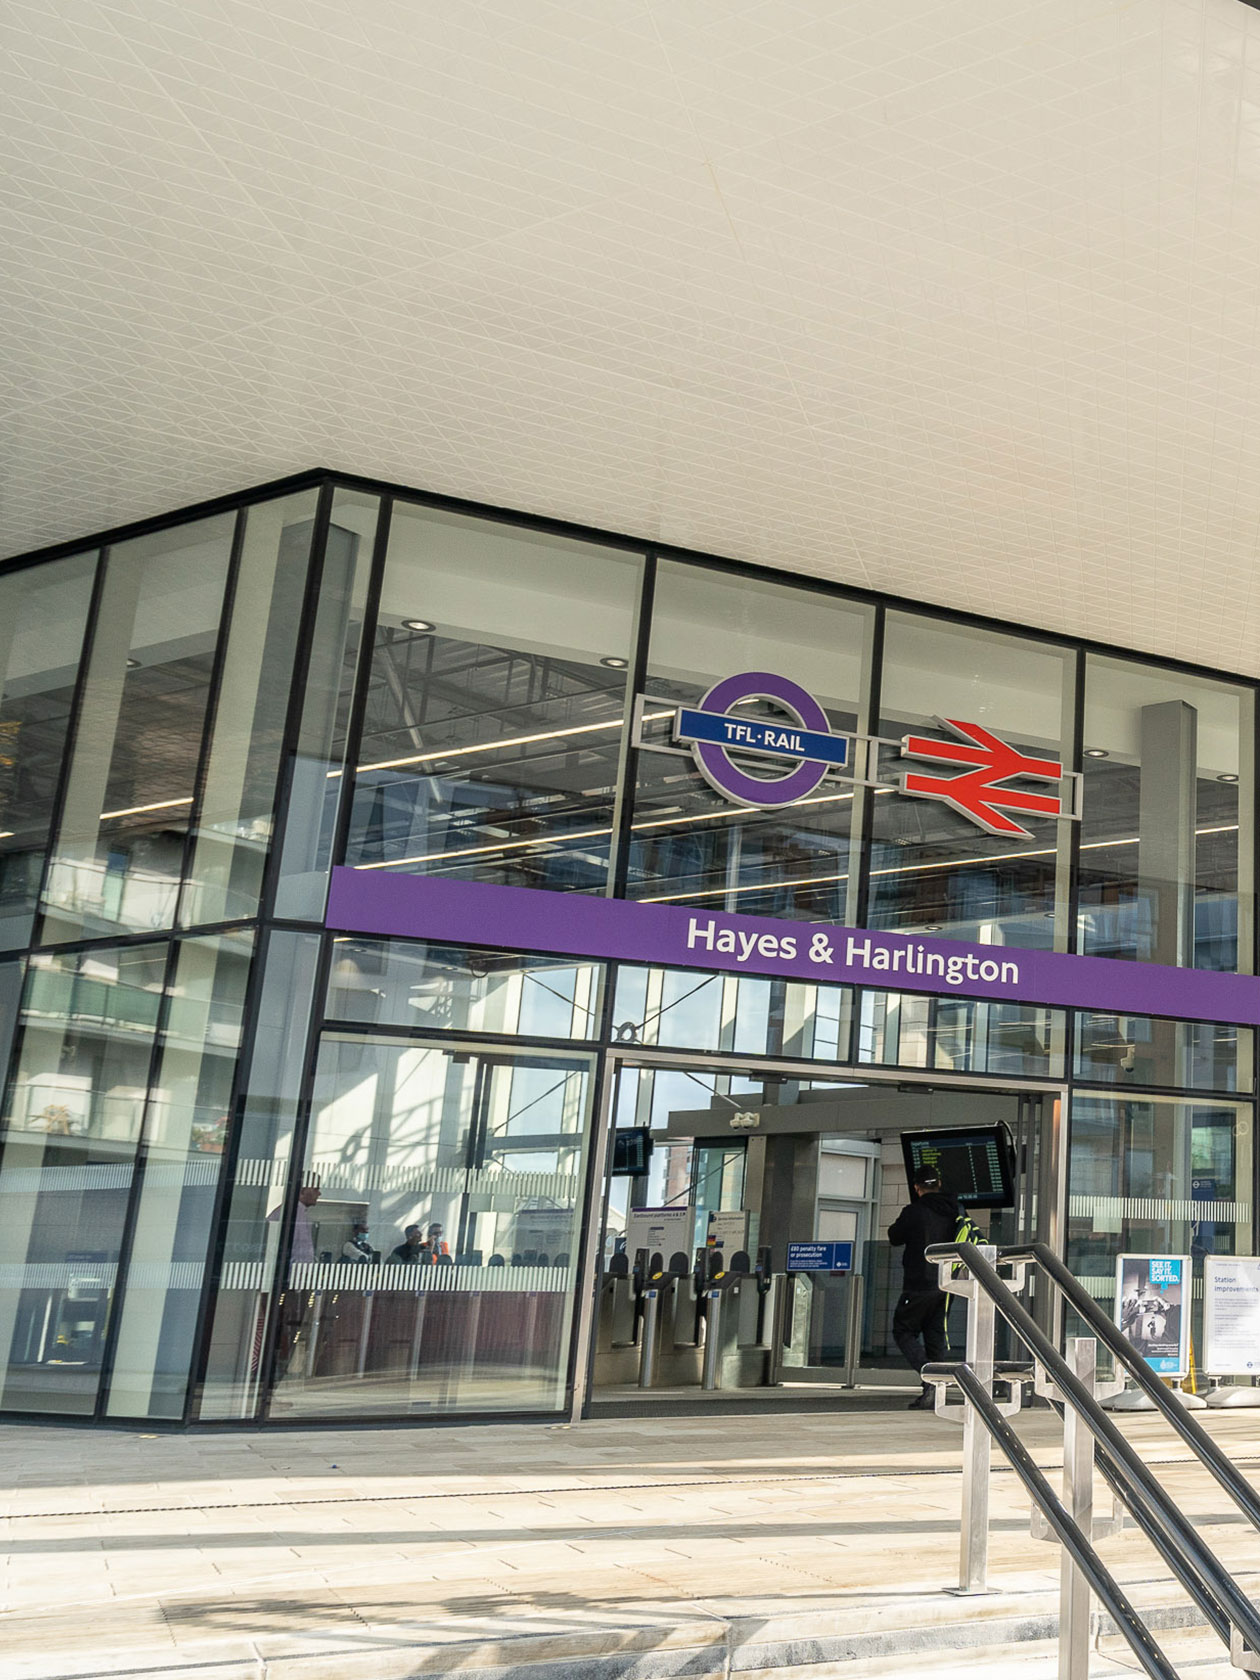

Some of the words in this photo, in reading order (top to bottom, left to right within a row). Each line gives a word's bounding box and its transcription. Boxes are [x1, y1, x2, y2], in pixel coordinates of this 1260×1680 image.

[687, 918, 797, 962] Hayes
[808, 933, 834, 964] &
[846, 936, 1020, 985] Harlington
[1152, 1267, 1164, 1275] SAY
[1152, 1274, 1180, 1282] SORTED.
[1214, 1285, 1259, 1293] Improvements
